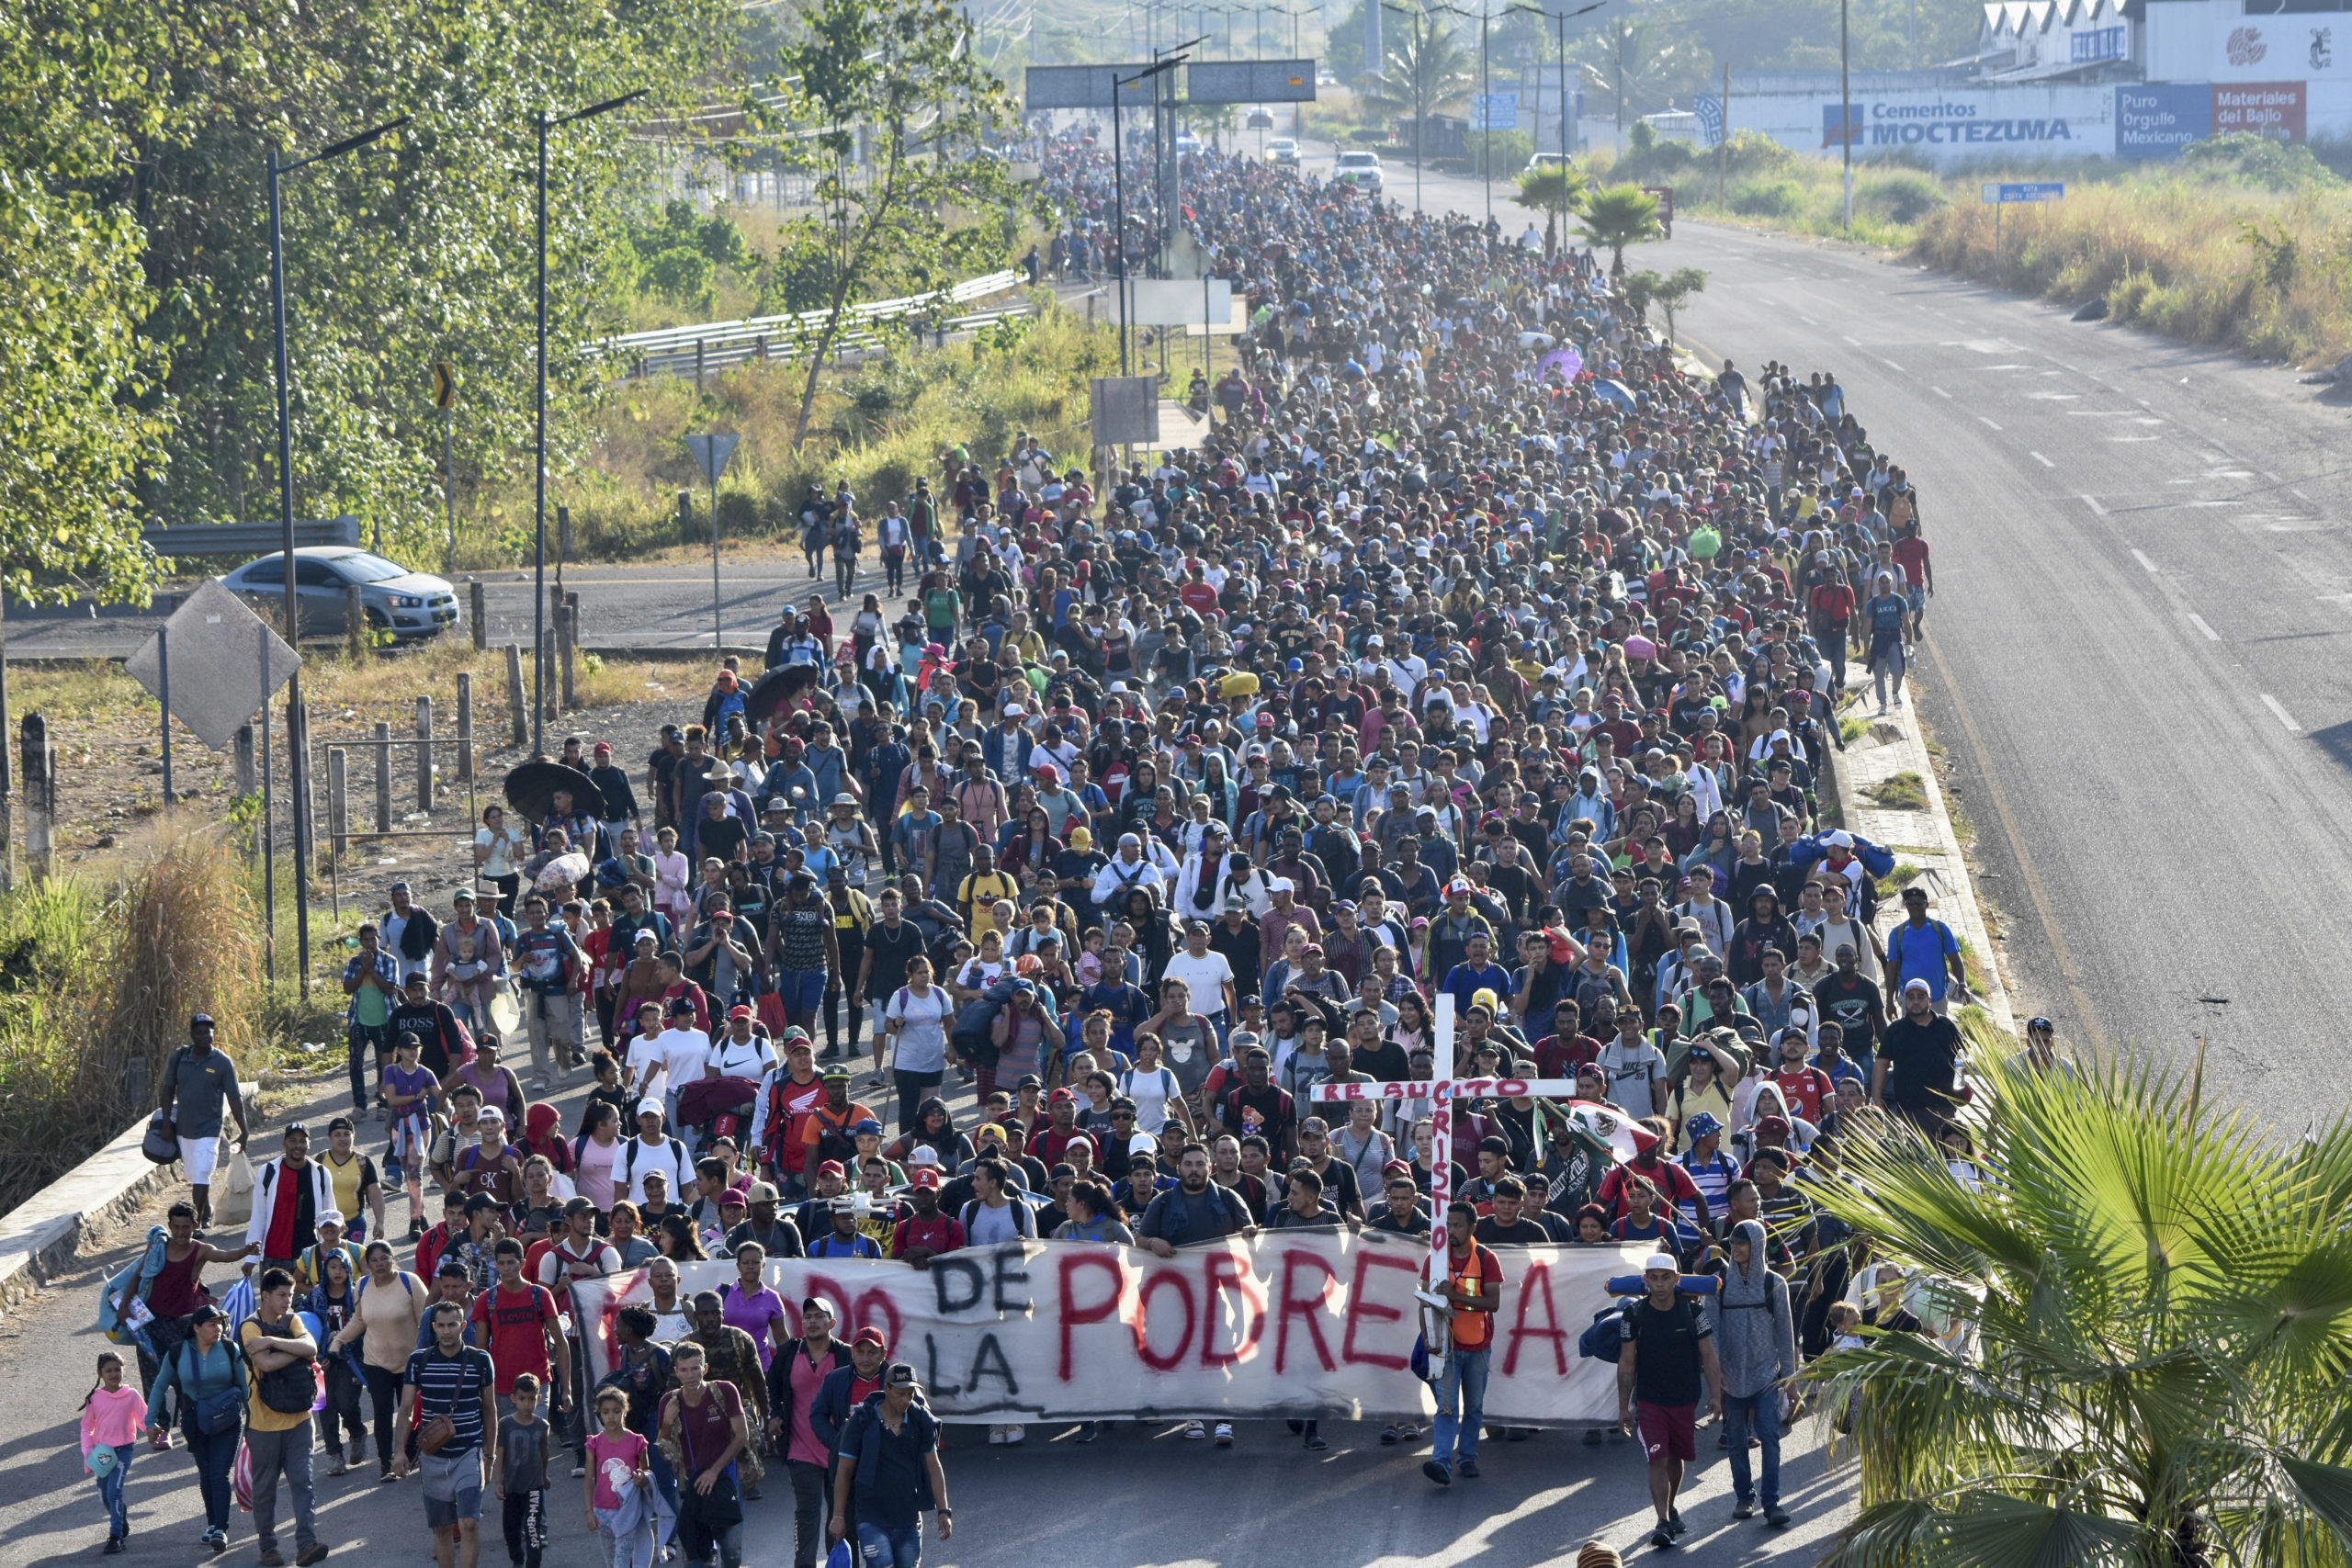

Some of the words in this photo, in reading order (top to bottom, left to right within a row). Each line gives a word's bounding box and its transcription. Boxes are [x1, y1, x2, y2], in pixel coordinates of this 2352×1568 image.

[2122, 94, 2157, 107] Puro
[2218, 91, 2296, 106] Materiales
[1871, 102, 1976, 118] Cementos
[2218, 109, 2241, 123] del
[2123, 112, 2176, 130] Orgullo
[1872, 118, 2071, 145] MOCTEZUMA
[2123, 130, 2192, 144] Mexicano
[399, 1018, 435, 1030] BOSS
[1623, 1062, 1641, 1071] NIKE
[1431, 1080, 1452, 1252] CRISTO
[931, 1245, 1031, 1314] DE
[1058, 1249, 1567, 1382] POBREA
[925, 1333, 1019, 1396] LA
[527, 1490, 540, 1550] SPIDER-MAN
